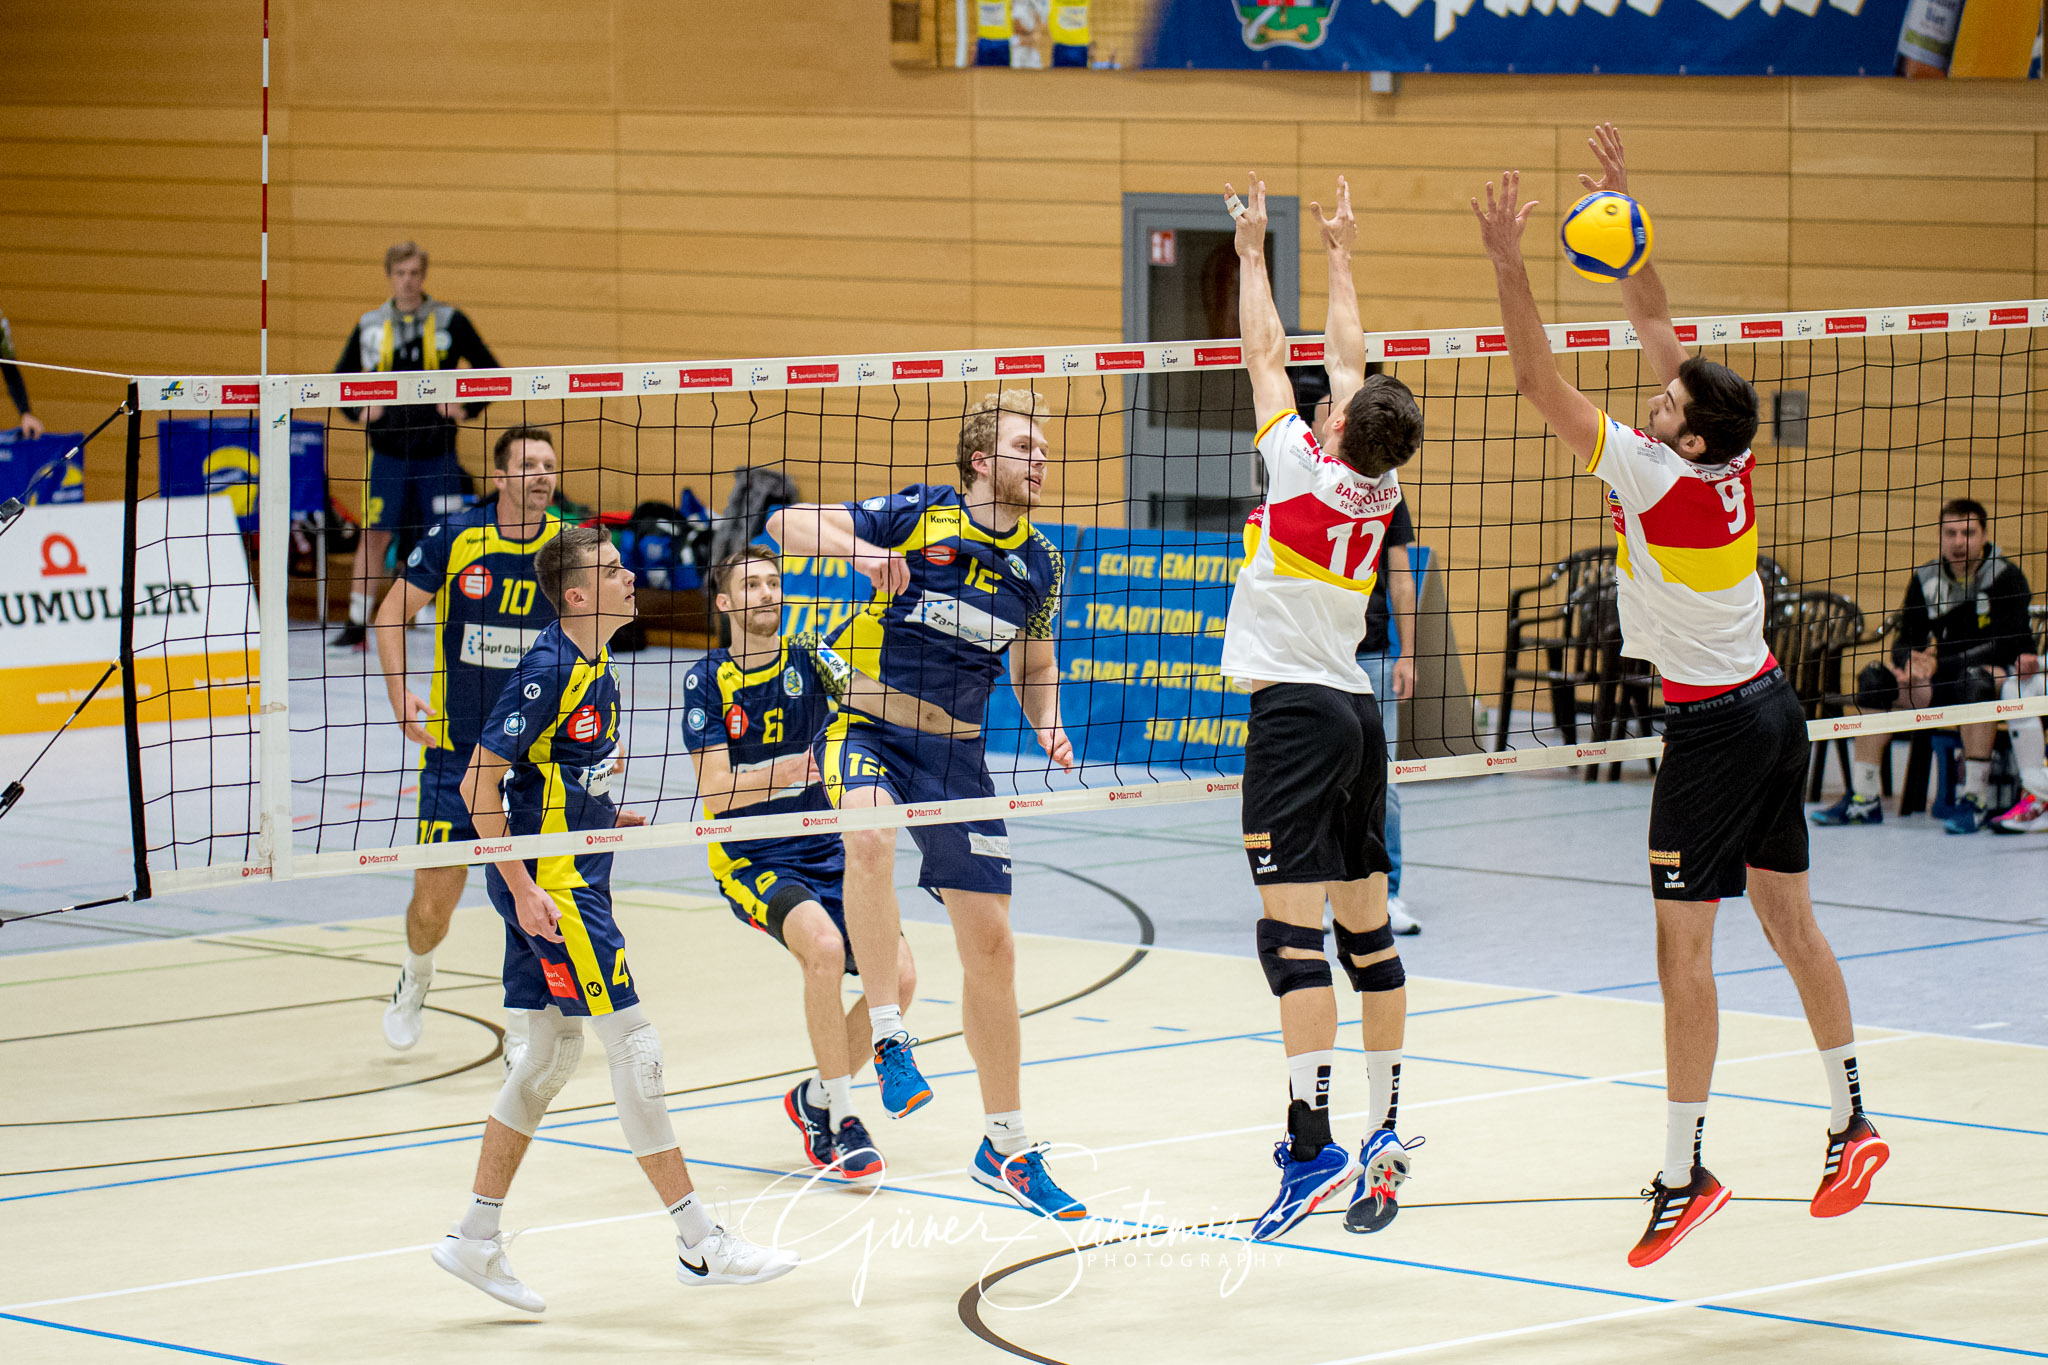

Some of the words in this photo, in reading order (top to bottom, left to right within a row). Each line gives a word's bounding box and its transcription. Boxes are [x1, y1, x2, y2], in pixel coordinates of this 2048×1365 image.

[1450, 344, 1462, 352] Zapf
[1167, 357, 1179, 365] Zapf
[863, 370, 876, 378] Zapf
[966, 366, 979, 374] Zapf
[648, 379, 662, 388] Zapf
[757, 375, 769, 383] Zapf
[537, 383, 551, 392] Zapf
[306, 392, 320, 401] Zapf
[423, 388, 437, 397] Zapf
[1715, 477, 1746, 534] 9
[1326, 520, 1386, 580] 12
[1098, 553, 1156, 578] ECHTE
[498, 578, 537, 616] 10
[1085, 602, 1203, 639] TRADITION
[1069, 658, 1138, 685] STARKE
[2001, 704, 2024, 712] Marmot
[1921, 713, 1943, 721] Marmot
[762, 707, 784, 744] 6
[1144, 717, 1174, 741] SEI
[1839, 722, 1862, 731] Marmot
[1582, 747, 1606, 756] Marmot
[1493, 756, 1517, 765] Marmot
[1402, 765, 1427, 774] Marmot
[1213, 782, 1240, 791] Marmot
[1115, 791, 1142, 800] Marmot
[1016, 799, 1043, 808] Marmot
[914, 808, 942, 817] Marmot
[810, 816, 838, 826] Marmot
[703, 825, 732, 835] Marmot
[594, 834, 624, 844] Marmot
[482, 844, 512, 854] Marmot
[368, 854, 399, 864] Marmot
[612, 948, 630, 989] 4
